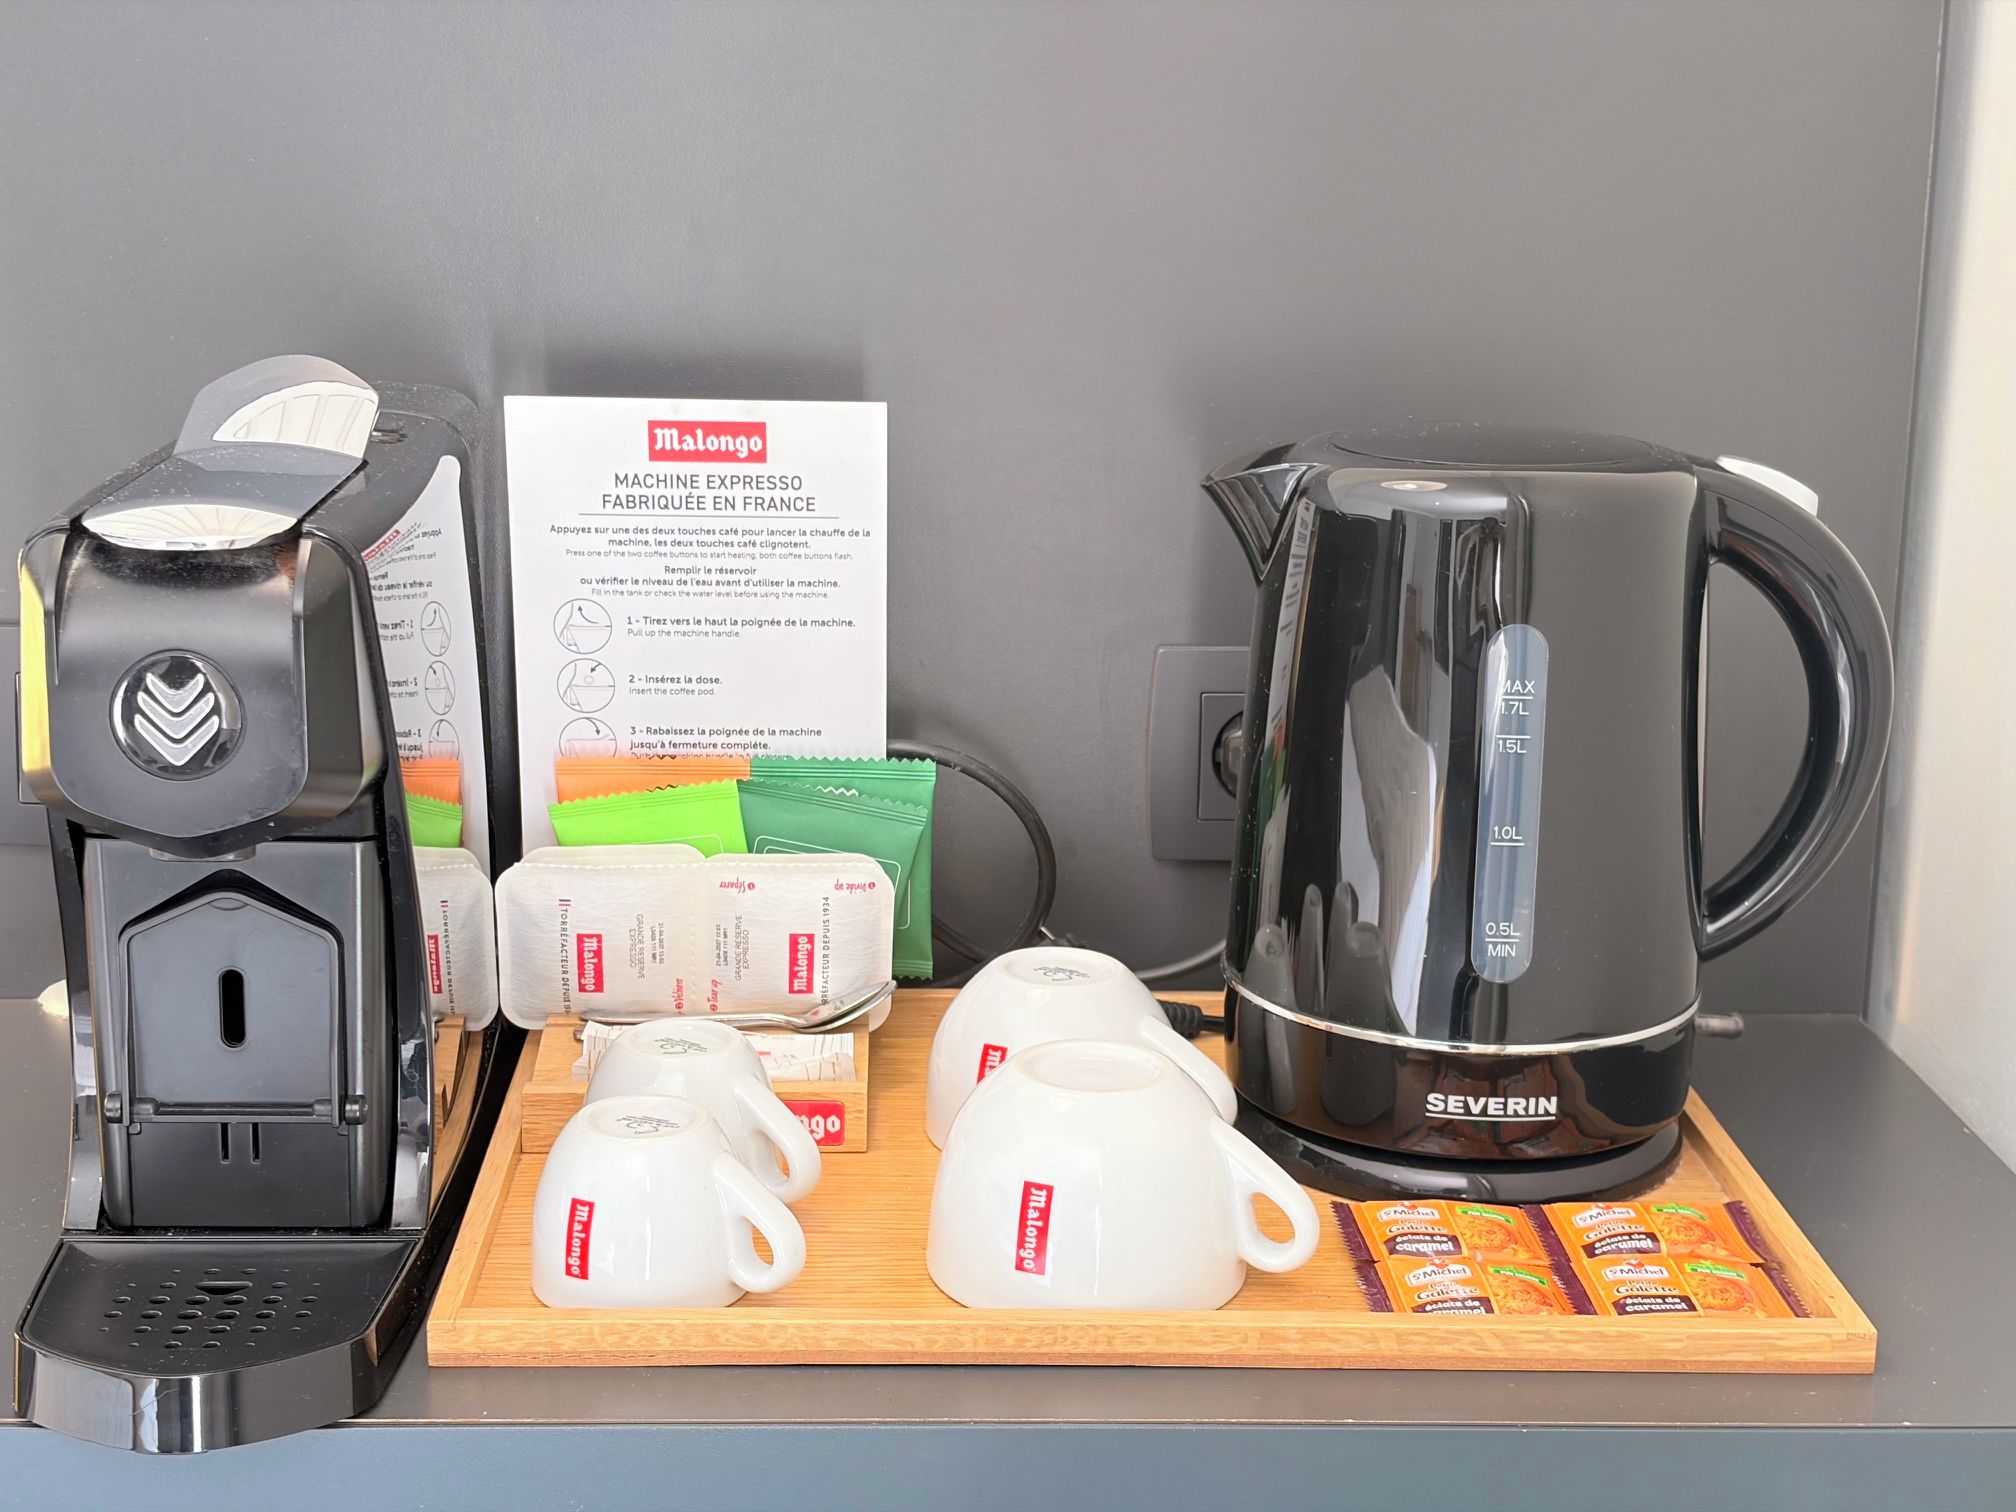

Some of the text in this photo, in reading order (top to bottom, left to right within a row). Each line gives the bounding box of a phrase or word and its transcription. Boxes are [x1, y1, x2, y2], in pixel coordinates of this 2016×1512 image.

[653, 427, 763, 459] Malongo
[614, 473, 803, 491] MACHINE EXPRESSO
[602, 492, 816, 513] FABRIQUÉE EN FRANCE
[550, 524, 871, 539] Appuyez sur une des deux touches café pour lancer la chauffe de la
[607, 537, 812, 551] machine, les deux touches café clignotent.
[565, 549, 586, 557] Press
[586, 550, 603, 558] one
[603, 549, 613, 558] of
[612, 550, 627, 558] the
[627, 550, 644, 558] two
[643, 550, 669, 558] coffee
[669, 550, 699, 559] buttons
[699, 551, 709, 559] to
[709, 551, 727, 559] start
[758, 551, 778, 560] both
[778, 552, 803, 560] coffee
[803, 552, 833, 560] buttons
[664, 566, 757, 576] Remplir le réservoir
[580, 576, 841, 588] ou vérifier le niveau de l'eau avant d'utiliser la machine.
[591, 588, 603, 596] Fill
[611, 589, 625, 597] the
[626, 589, 643, 597] tank
[678, 589, 691, 598] the
[692, 590, 714, 598] water
[714, 590, 734, 598] level
[733, 590, 759, 598] before
[759, 591, 780, 600] using
[781, 591, 794, 599] the
[627, 616, 856, 629] 1 Tirez vers le haut la poignée de la machine.
[627, 628, 644, 637] Pull
[644, 630, 657, 638] up
[657, 629, 672, 637] the
[673, 628, 710, 638] machine
[628, 674, 723, 685] 2 Insérez la dose.
[653, 687, 668, 695] the
[669, 687, 696, 696] coffee
[1501, 680, 1535, 694] MAX
[1500, 701, 1530, 715] 1.7L
[629, 726, 823, 738] 3 Rabaissez la poignée de la machine
[630, 740, 666, 751] jusqu'à
[668, 740, 719, 750] fermeture
[1497, 739, 1527, 753] 1.5L
[1493, 826, 1522, 841] 1.0L
[822, 896, 830, 917] 1934
[822, 919, 830, 951] DEPUIS
[1485, 922, 1520, 937] 0.5L
[560, 908, 569, 976] TORRÉFACTEUR
[742, 929, 750, 969] EXPRESSO
[1487, 943, 1516, 958] MIN
[580, 936, 599, 991] Malongo
[793, 936, 812, 992] Malongo
[1426, 1093, 1558, 1116] SEVERIN
[1019, 1186, 1048, 1272] Malongo
[569, 1203, 591, 1277] Malongo
[1395, 1242, 1454, 1252] caramel
[1594, 1238, 1654, 1255] caramel
[1422, 1267, 1467, 1280] Michel
[1619, 1267, 1664, 1276] Michel
[1464, 1299, 1480, 1307] de
[1664, 1296, 1681, 1304] de
[1625, 1303, 1688, 1312] caramel
